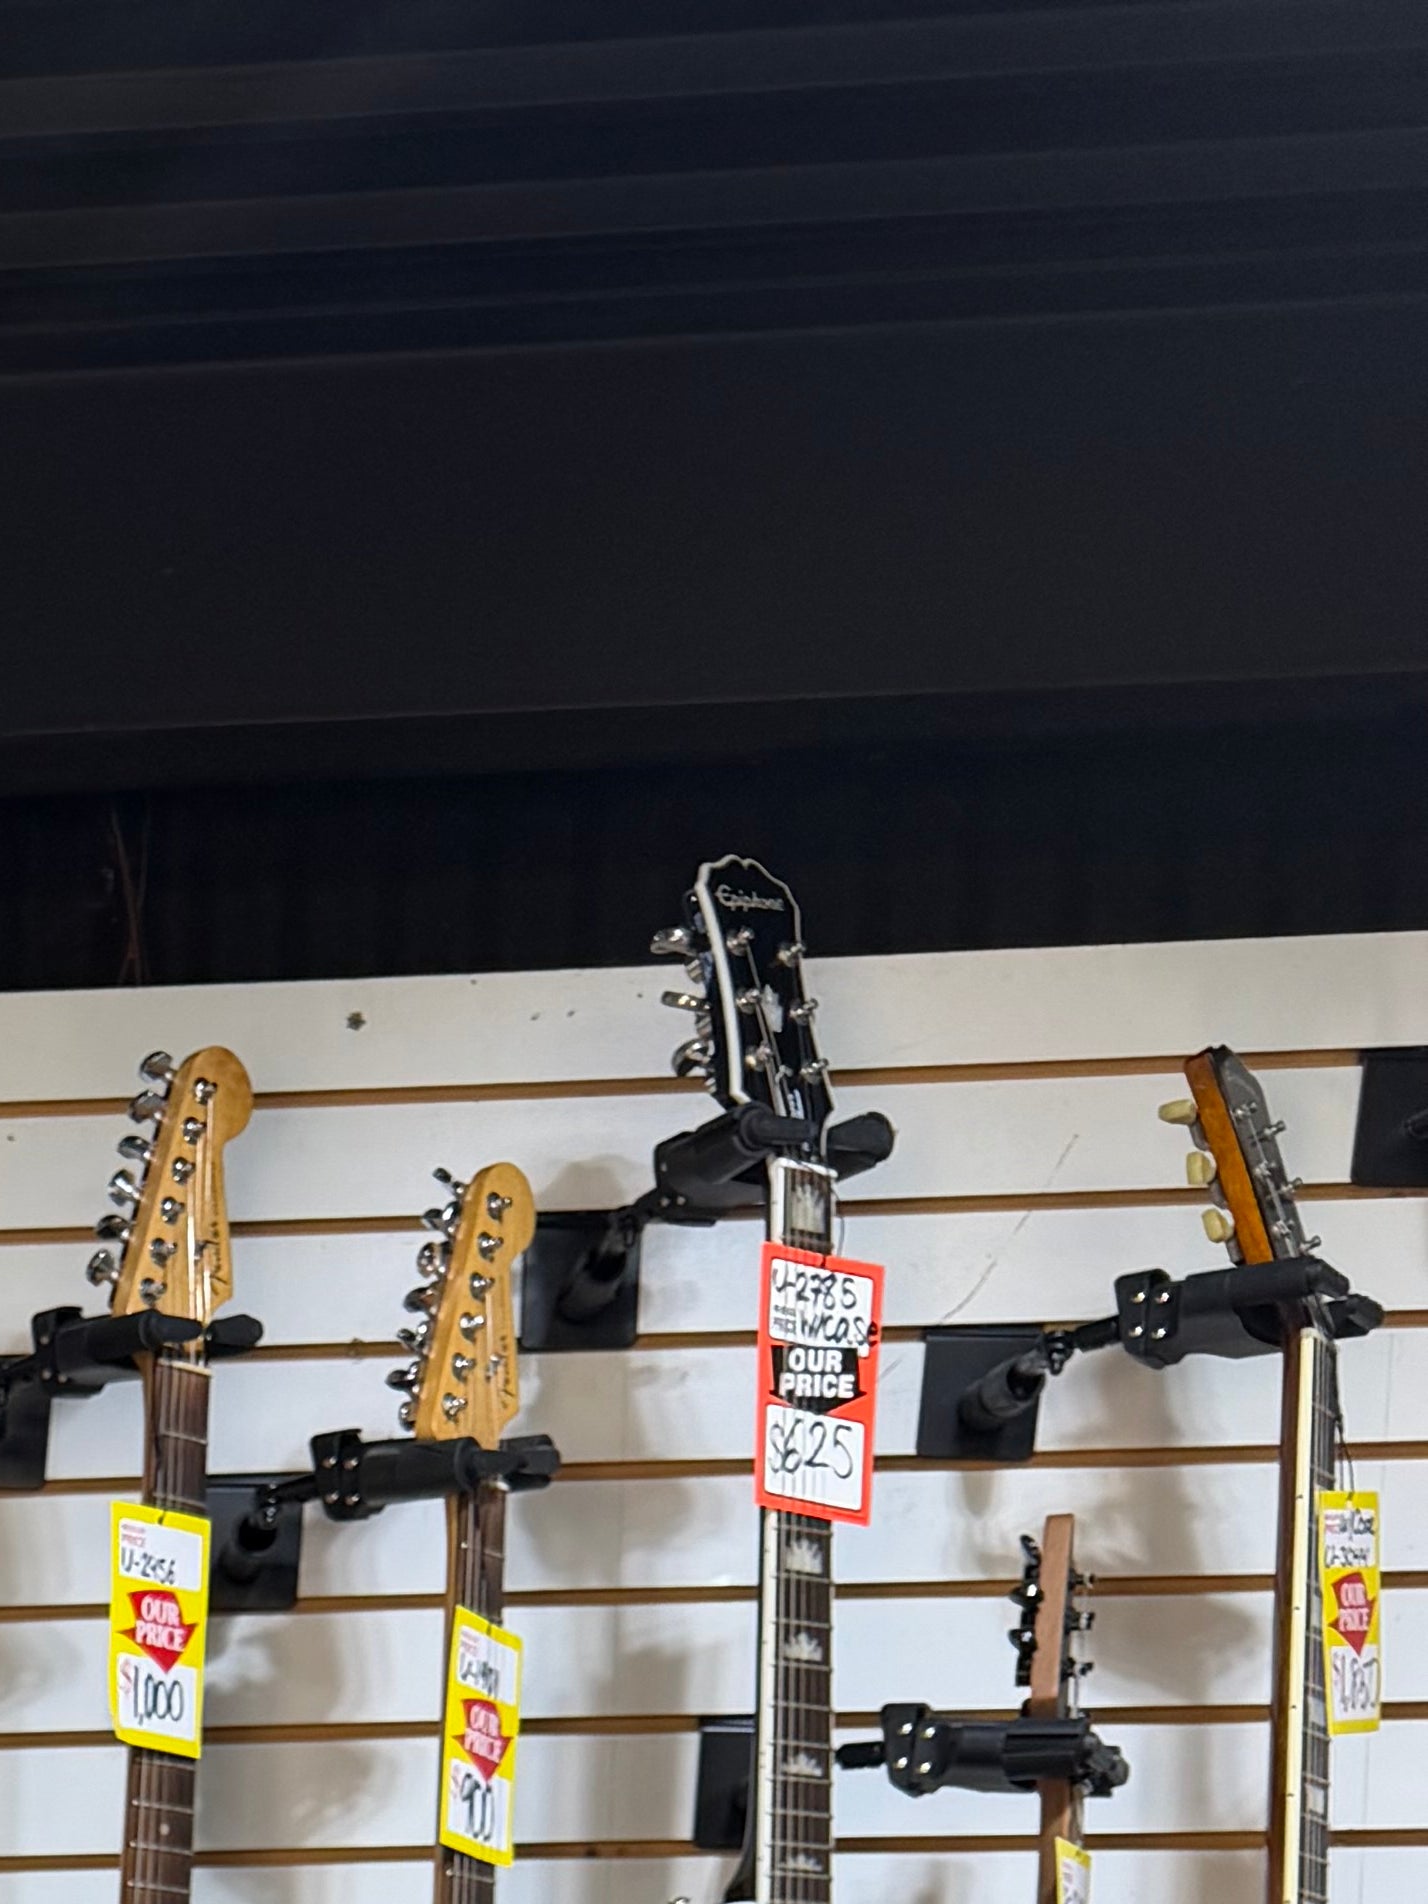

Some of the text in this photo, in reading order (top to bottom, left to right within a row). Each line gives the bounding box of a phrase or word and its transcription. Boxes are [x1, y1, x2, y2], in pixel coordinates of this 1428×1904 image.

[787, 1347, 843, 1374] OUR
[779, 1373, 856, 1400] PRICE
[767, 1417, 854, 1480] $625
[139, 1594, 181, 1626] OUR
[134, 1619, 187, 1652] PRICE
[118, 1659, 185, 1726] $1,000
[469, 1703, 501, 1735] OUR
[464, 1727, 503, 1764] PRICE
